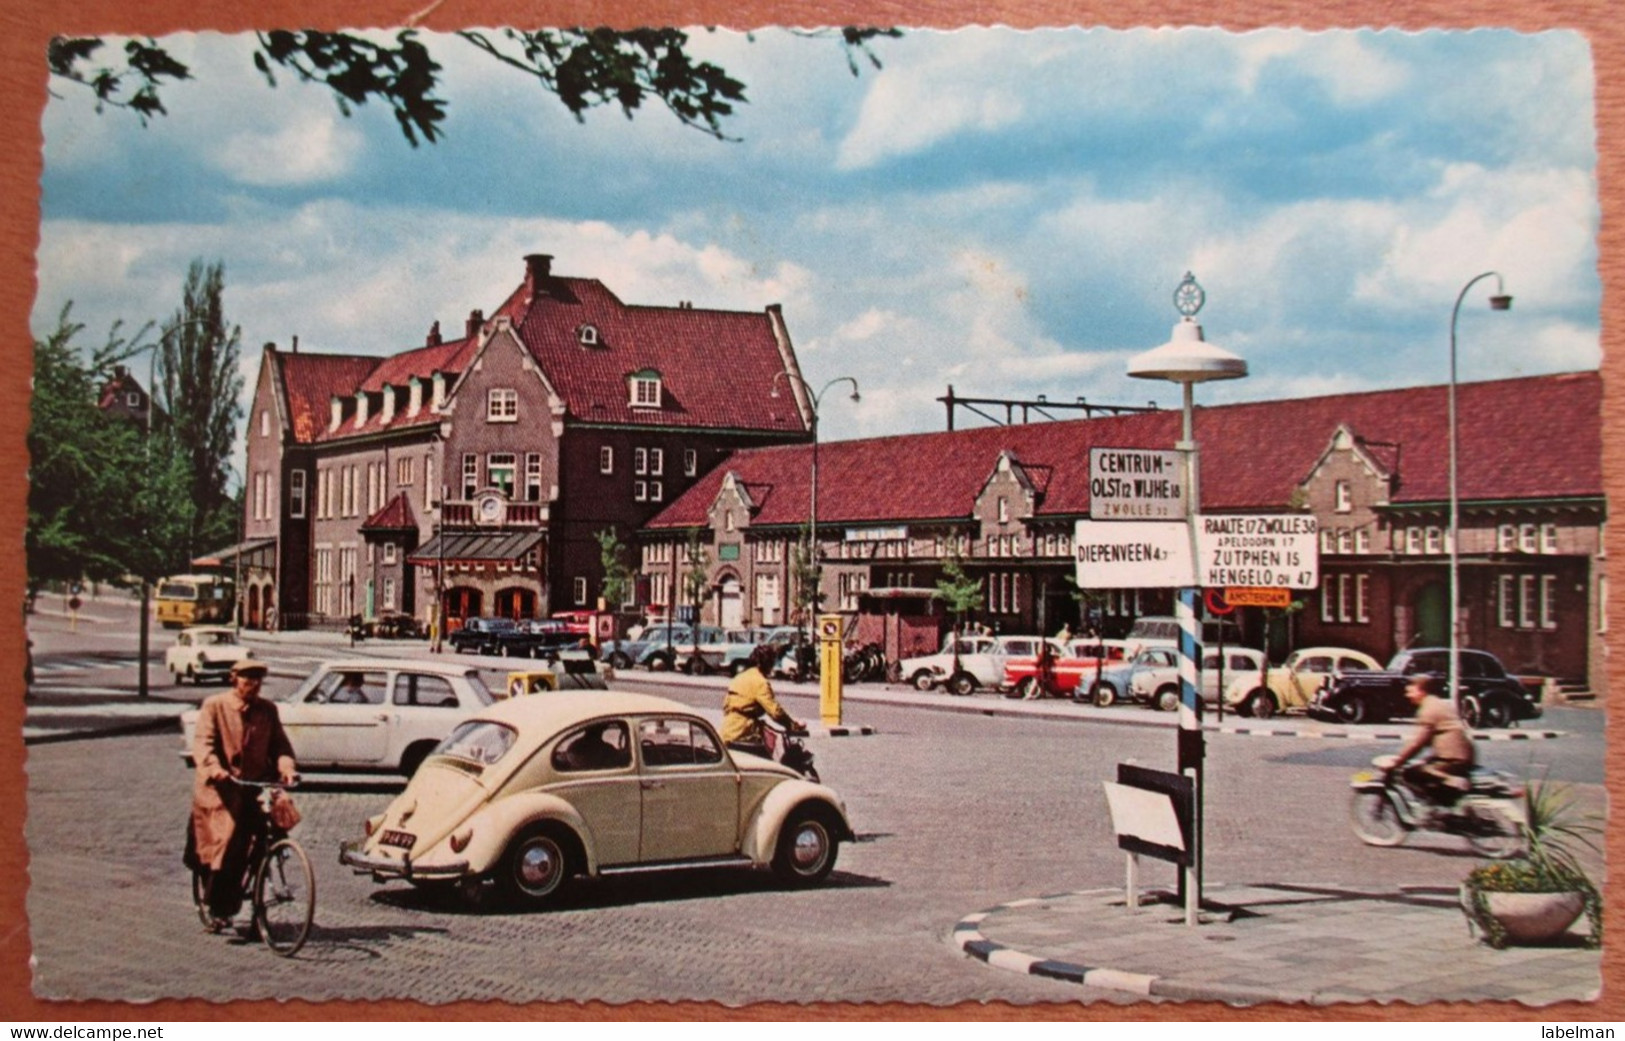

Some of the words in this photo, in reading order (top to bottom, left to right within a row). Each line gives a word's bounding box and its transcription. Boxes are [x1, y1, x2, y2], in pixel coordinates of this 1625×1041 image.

[1104, 503, 1152, 516] ZWOLLE
[1205, 518, 1245, 534] RAALTE
[1257, 517, 1301, 535] ZWOLLE
[1301, 519, 1317, 533] 38
[1218, 537, 1275, 547] APELDOORN
[1283, 537, 1295, 547] 17
[1078, 543, 1152, 562] DIEPENVEEN
[1213, 549, 1281, 566] ZUTPHEN
[1287, 551, 1300, 566] 15
[1209, 568, 1273, 585] HENGELO
[1298, 571, 1313, 586] 47
[1229, 593, 1286, 602] AMSTERDAM
